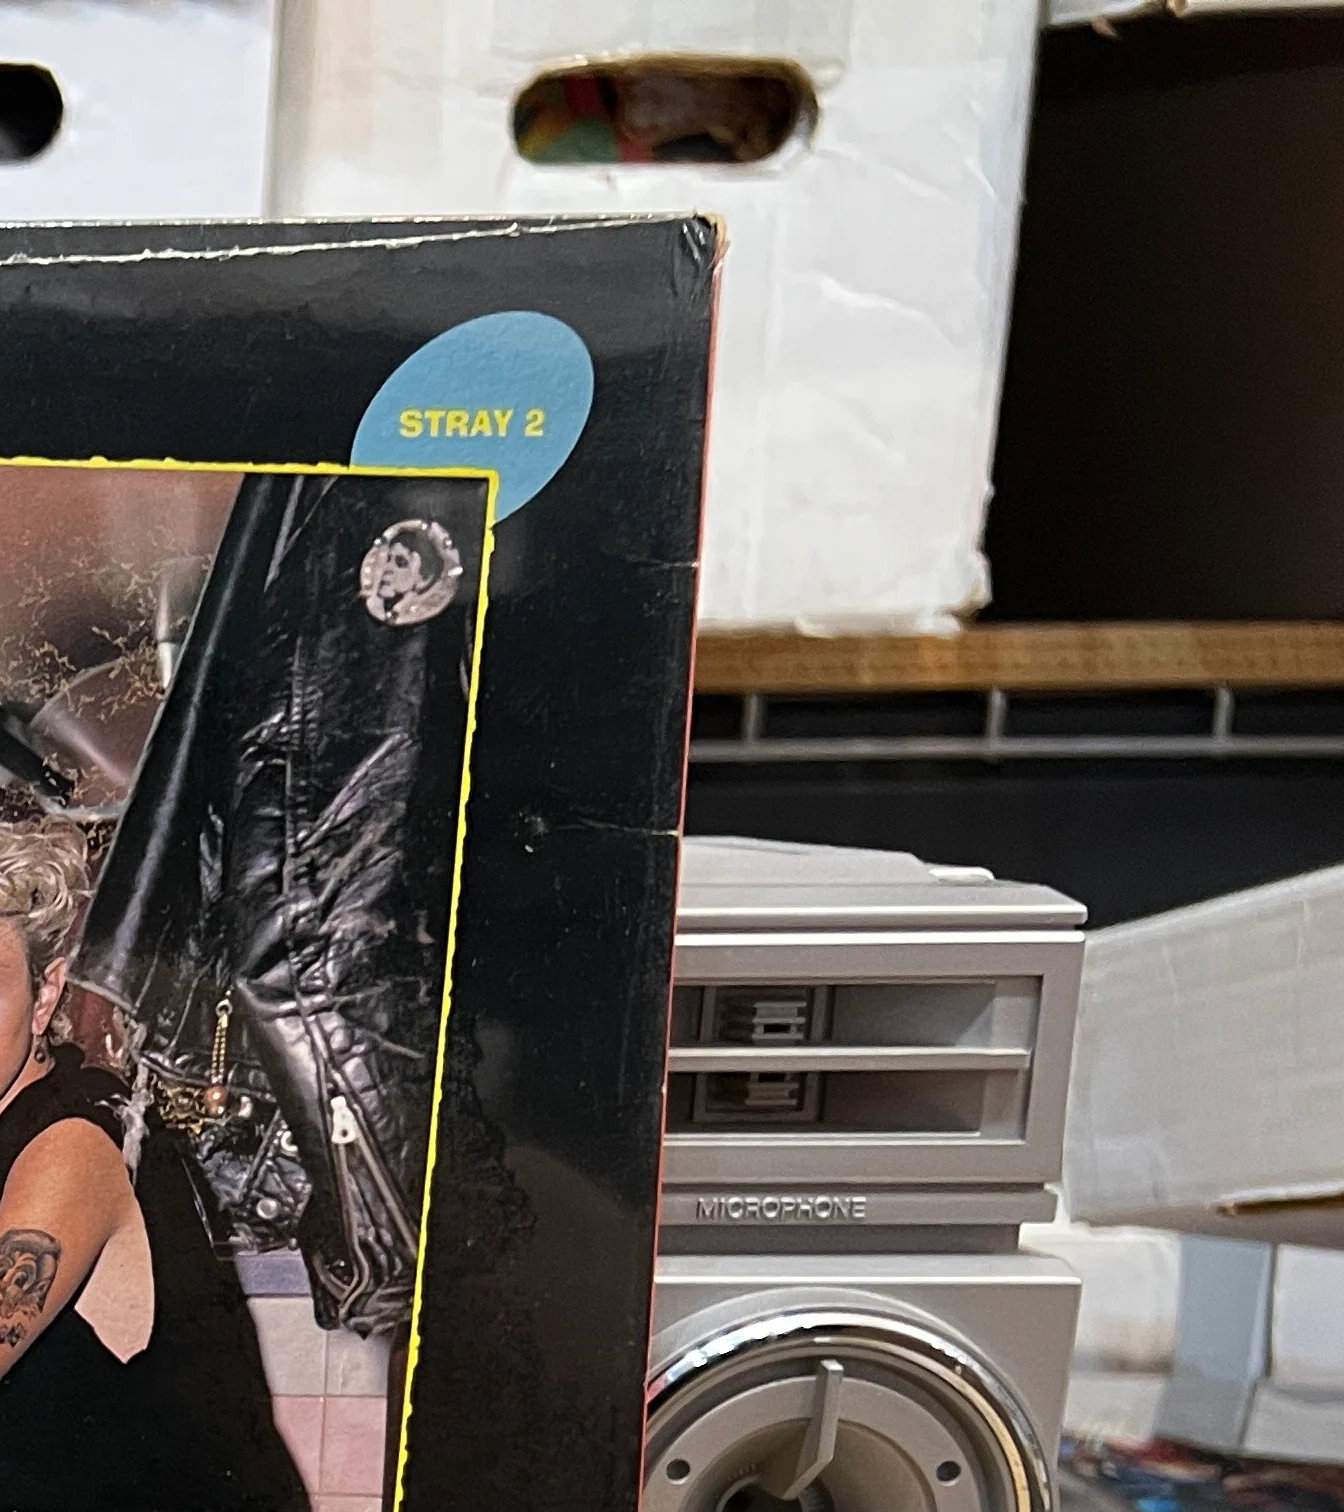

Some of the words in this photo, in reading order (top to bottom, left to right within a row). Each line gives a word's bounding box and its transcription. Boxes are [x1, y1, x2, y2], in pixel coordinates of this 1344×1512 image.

[398, 407, 514, 438] STRAY
[523, 408, 546, 437] 2
[695, 1194, 868, 1220] MICROPHONE
